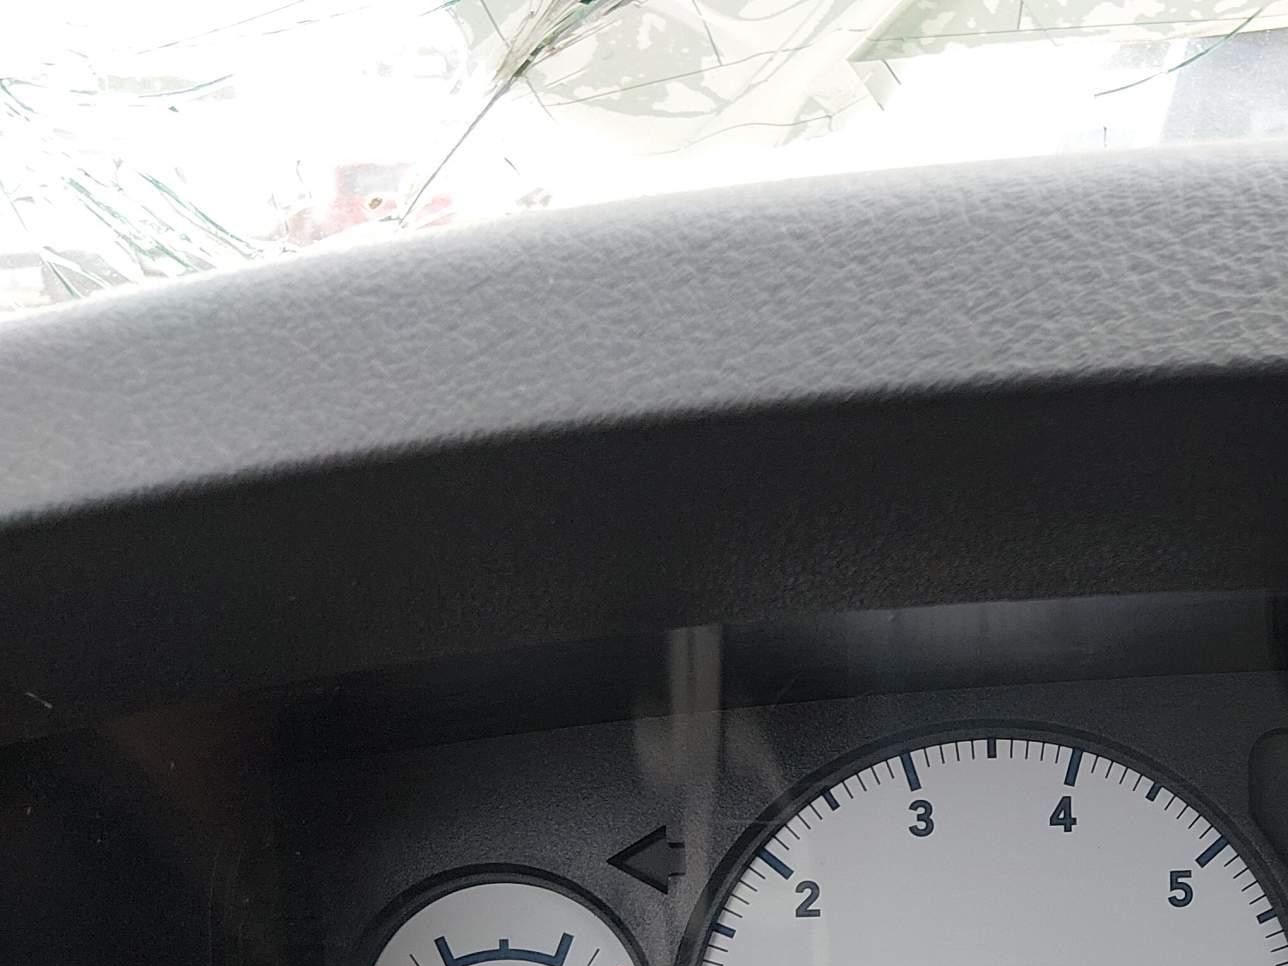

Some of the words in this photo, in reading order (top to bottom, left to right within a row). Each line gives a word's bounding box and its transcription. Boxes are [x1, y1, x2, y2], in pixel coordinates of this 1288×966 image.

[908, 799, 935, 838] 3
[1049, 795, 1077, 833] 4
[795, 880, 821, 918] 2
[1167, 869, 1194, 908] 5
